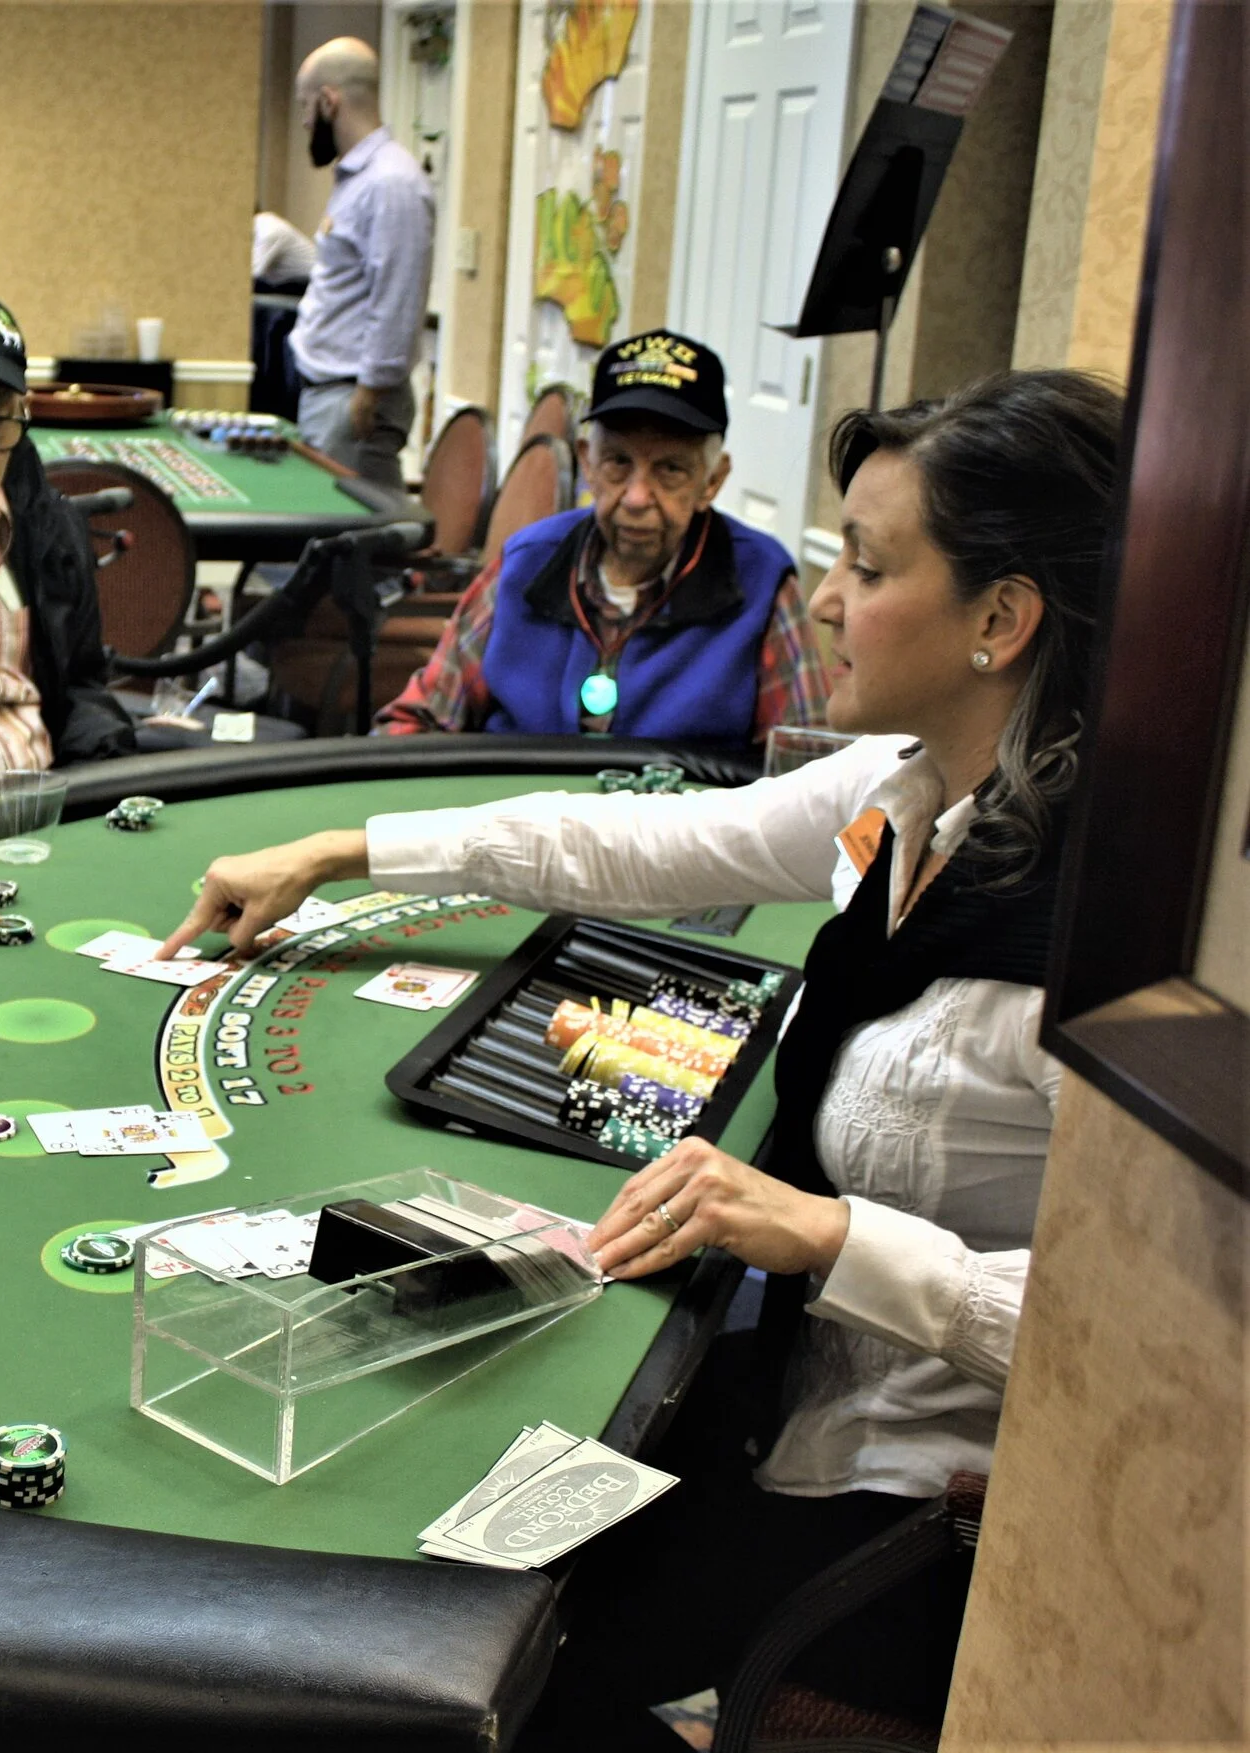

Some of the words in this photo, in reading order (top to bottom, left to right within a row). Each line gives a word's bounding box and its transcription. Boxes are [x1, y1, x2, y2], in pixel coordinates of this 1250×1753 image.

[391, 903, 513, 938] BLACK
[261, 928, 351, 974] MUST
[308, 933, 393, 974] JACK
[230, 974, 281, 1009] HIT
[271, 976, 329, 1020] PAYS
[166, 1024, 201, 1066] PAYS
[214, 1011, 254, 1070] SOFT
[265, 1025, 300, 1038] 3
[168, 1069, 199, 1083] 2
[264, 1044, 305, 1075] TO
[174, 1084, 203, 1104] TO
[220, 1076, 268, 1106] 17
[277, 1082, 317, 1095] 2
[151, 1262, 176, 1273] 4
[266, 1263, 293, 1274] 3
[504, 1471, 631, 1548] BEDFORD
